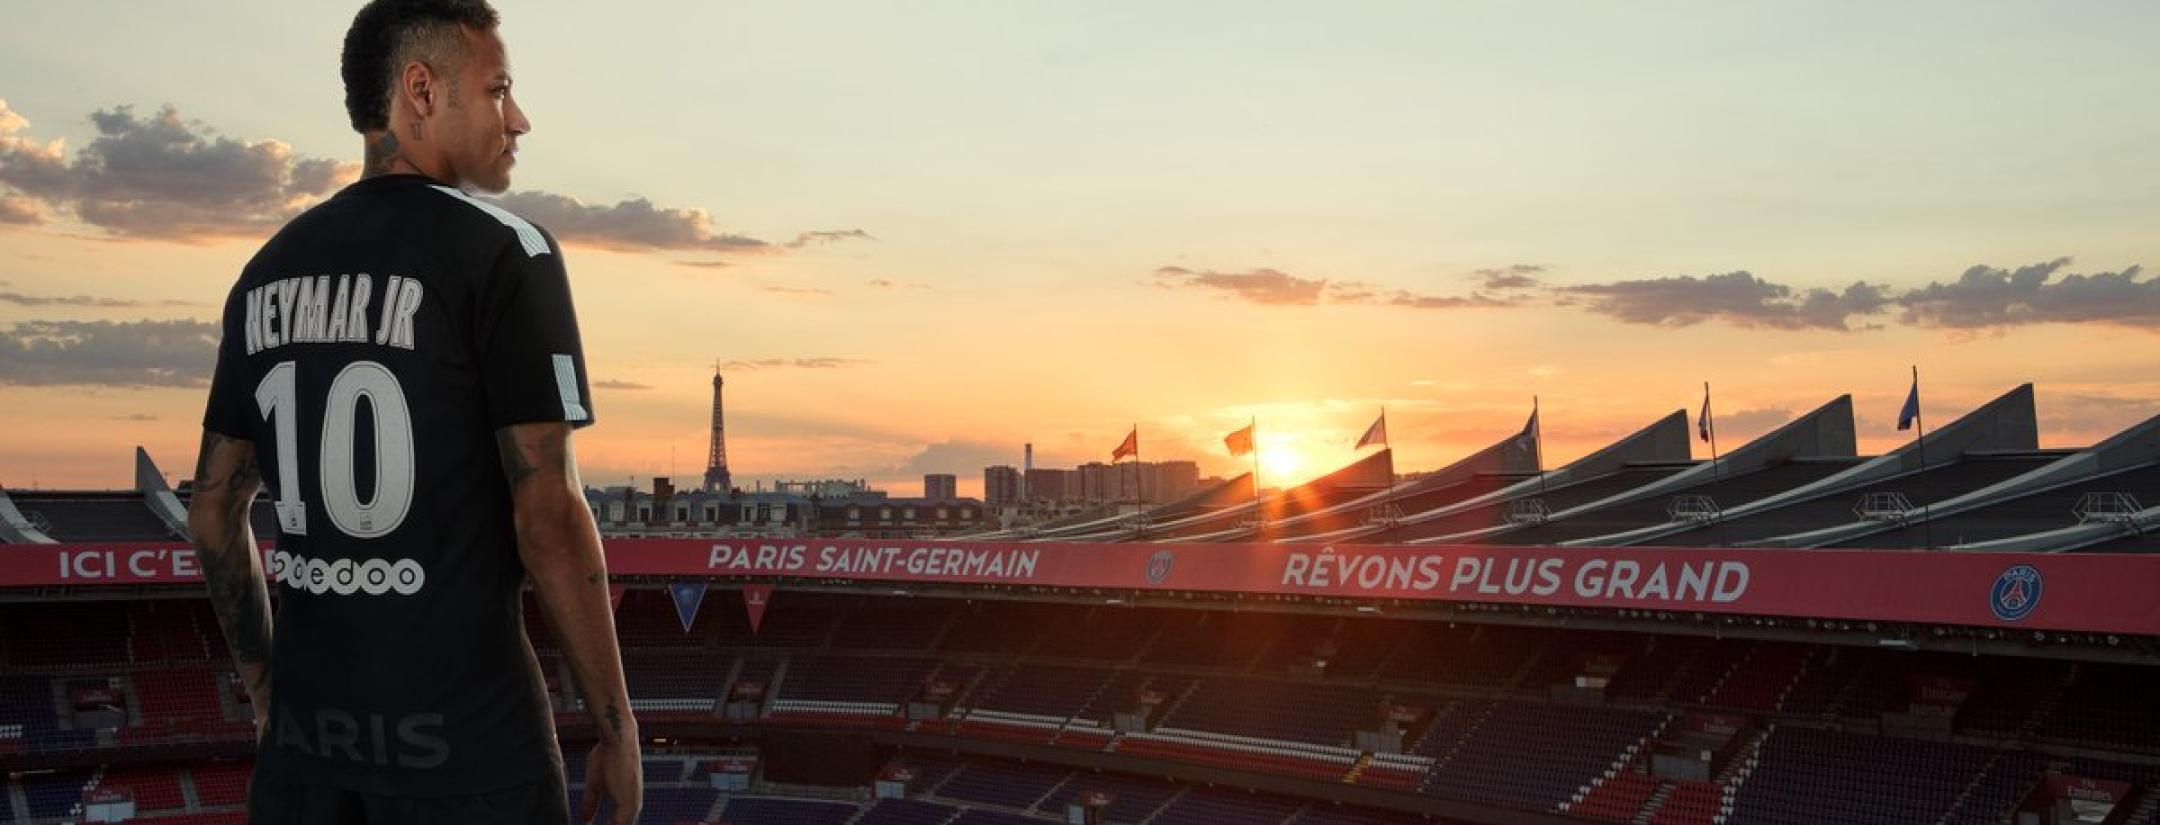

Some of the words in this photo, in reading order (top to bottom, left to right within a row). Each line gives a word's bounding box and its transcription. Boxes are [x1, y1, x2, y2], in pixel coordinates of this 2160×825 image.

[244, 274, 372, 356] NEYMAR
[376, 275, 424, 351] JR
[254, 360, 416, 539] 10
[59, 551, 116, 578] ICI
[129, 549, 202, 578] C'E
[708, 545, 807, 571] PARIS
[816, 545, 1040, 578] SAINT-GERMAIN
[1280, 545, 1443, 591] RÊVONS
[1448, 556, 1565, 596] PLUS
[1574, 558, 1749, 603] GRAND
[275, 703, 451, 769] ARIS
